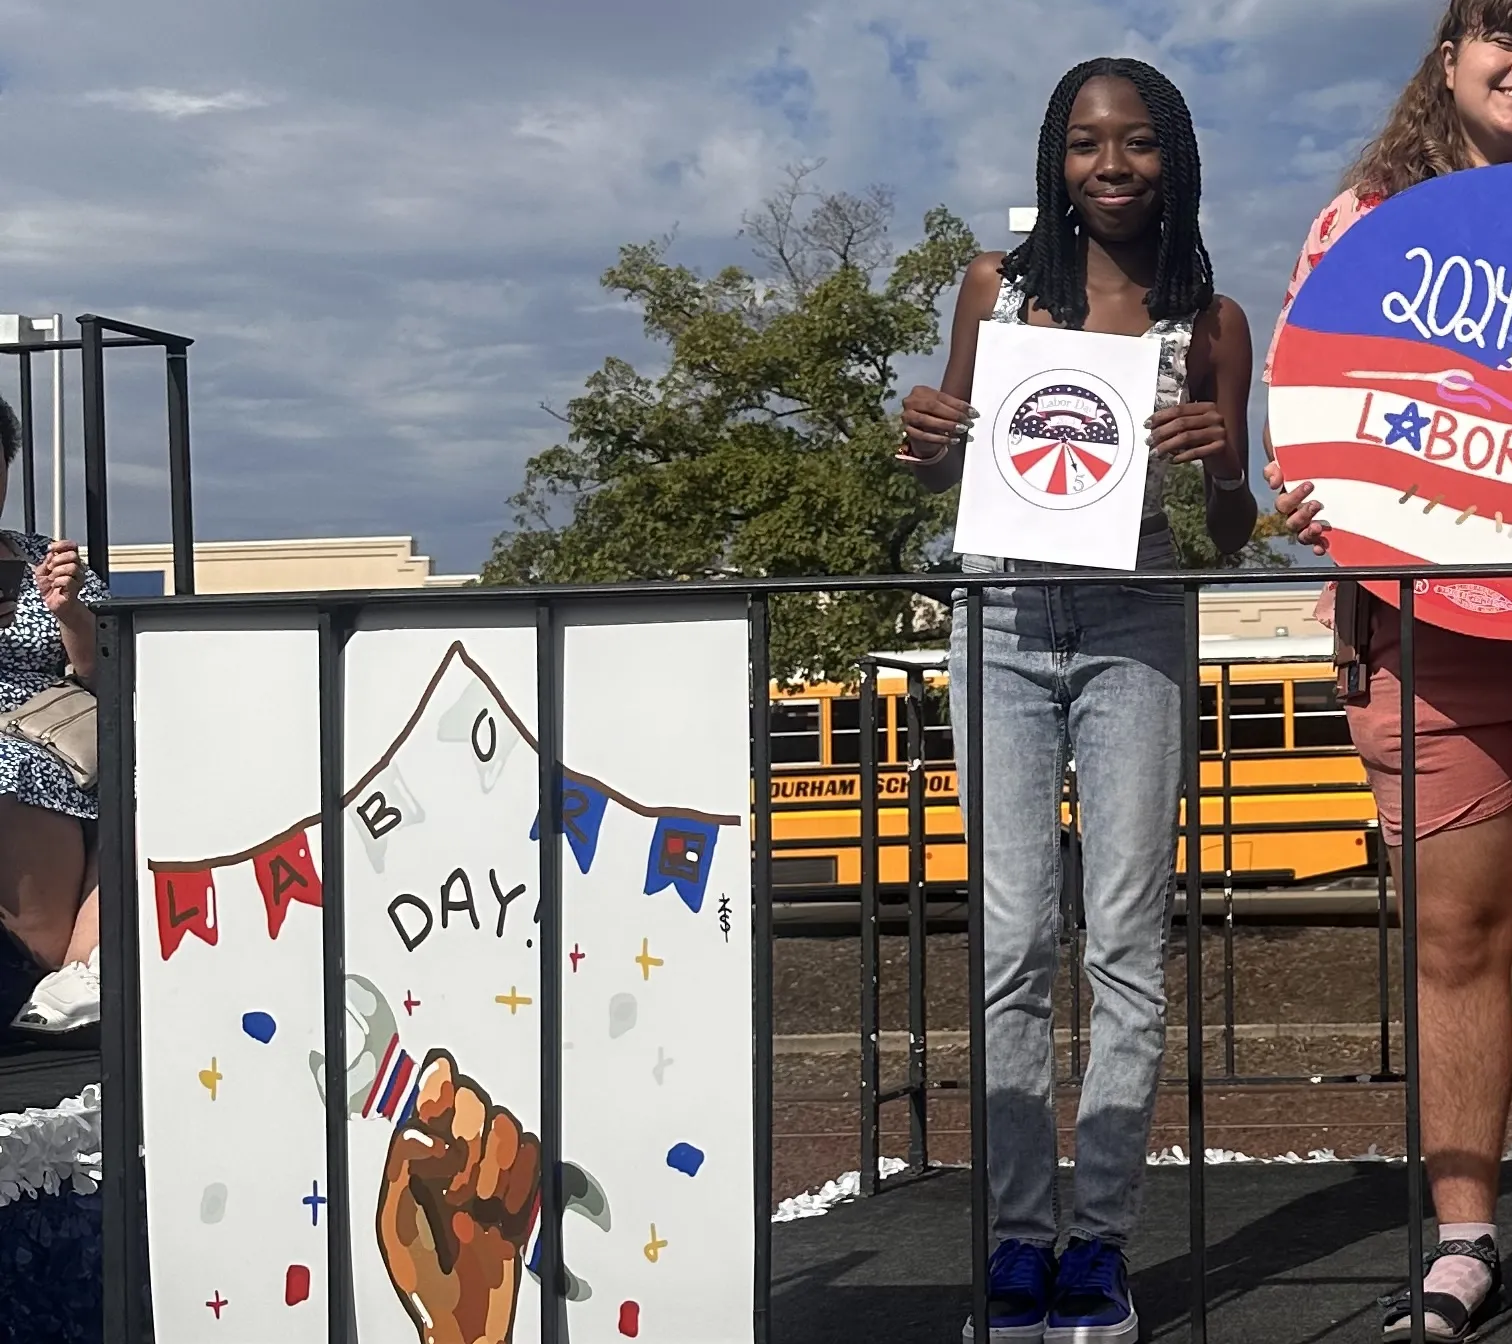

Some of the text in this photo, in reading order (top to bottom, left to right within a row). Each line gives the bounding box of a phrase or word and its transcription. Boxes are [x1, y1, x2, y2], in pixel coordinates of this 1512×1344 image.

[1073, 474, 1085, 492] 5
[770, 775, 955, 799] DURHAM SCHOL
